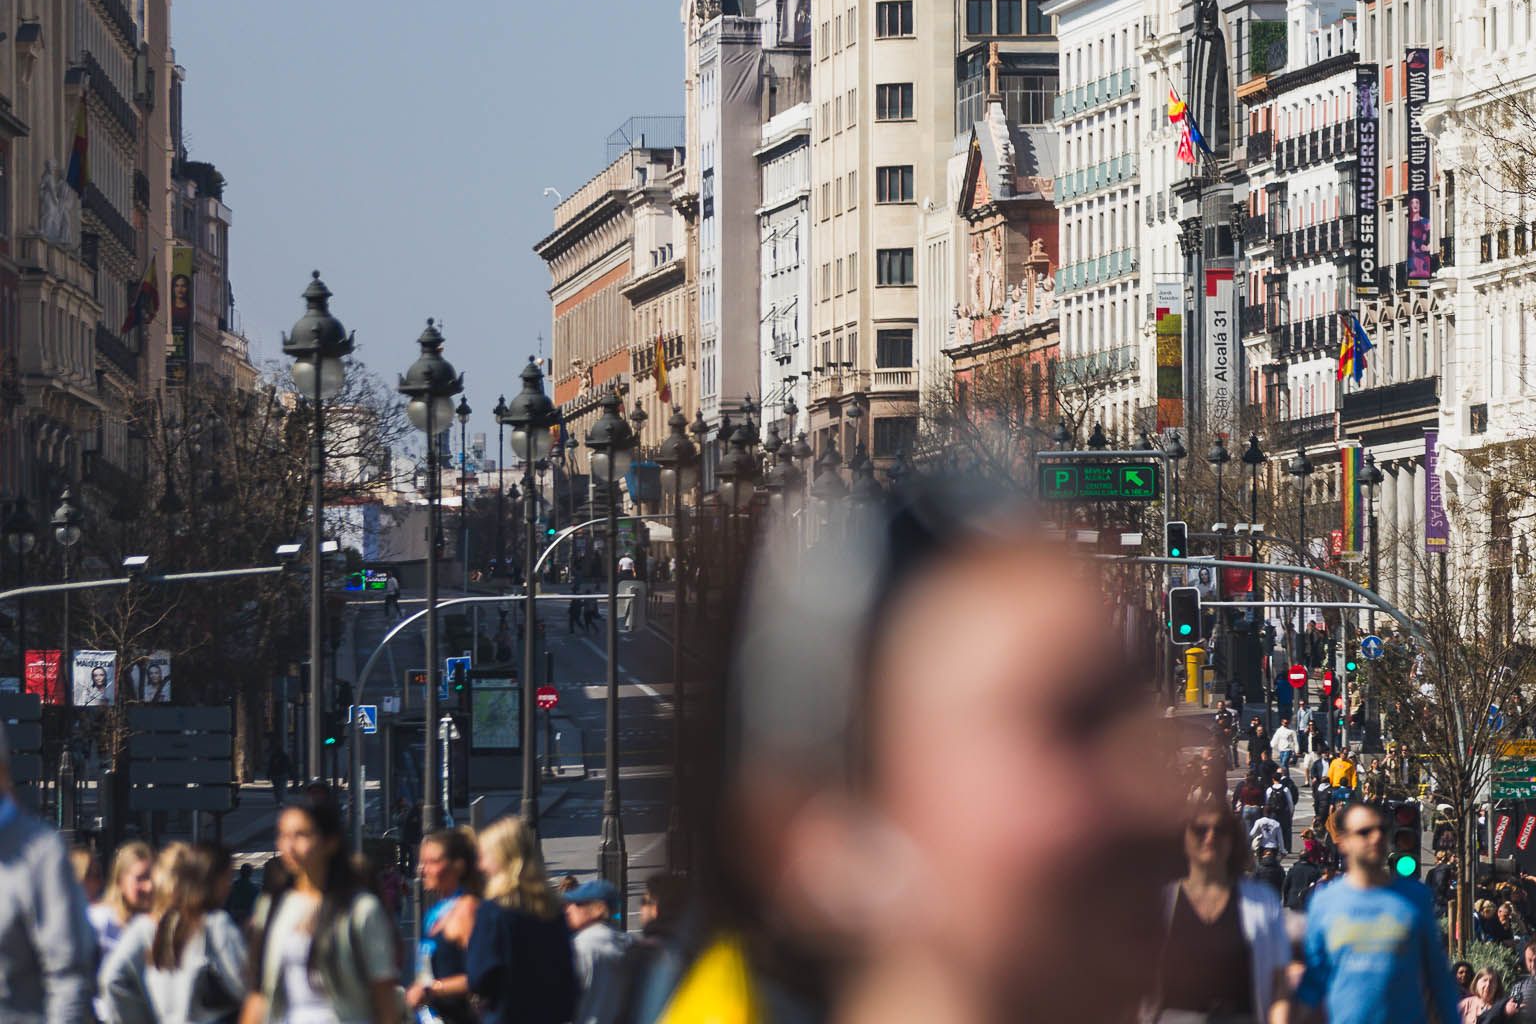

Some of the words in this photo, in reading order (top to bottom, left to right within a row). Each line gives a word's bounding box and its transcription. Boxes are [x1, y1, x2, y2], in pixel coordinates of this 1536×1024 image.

[1410, 71, 1426, 103] VIVAS
[1360, 121, 1374, 210] MUJERES
[1411, 166, 1424, 192] NOS
[1361, 214, 1374, 244] SER
[1361, 247, 1374, 283] POR
[1214, 310, 1227, 327] 31
[1213, 332, 1227, 382] Alcalá
[1056, 471, 1070, 488] P
